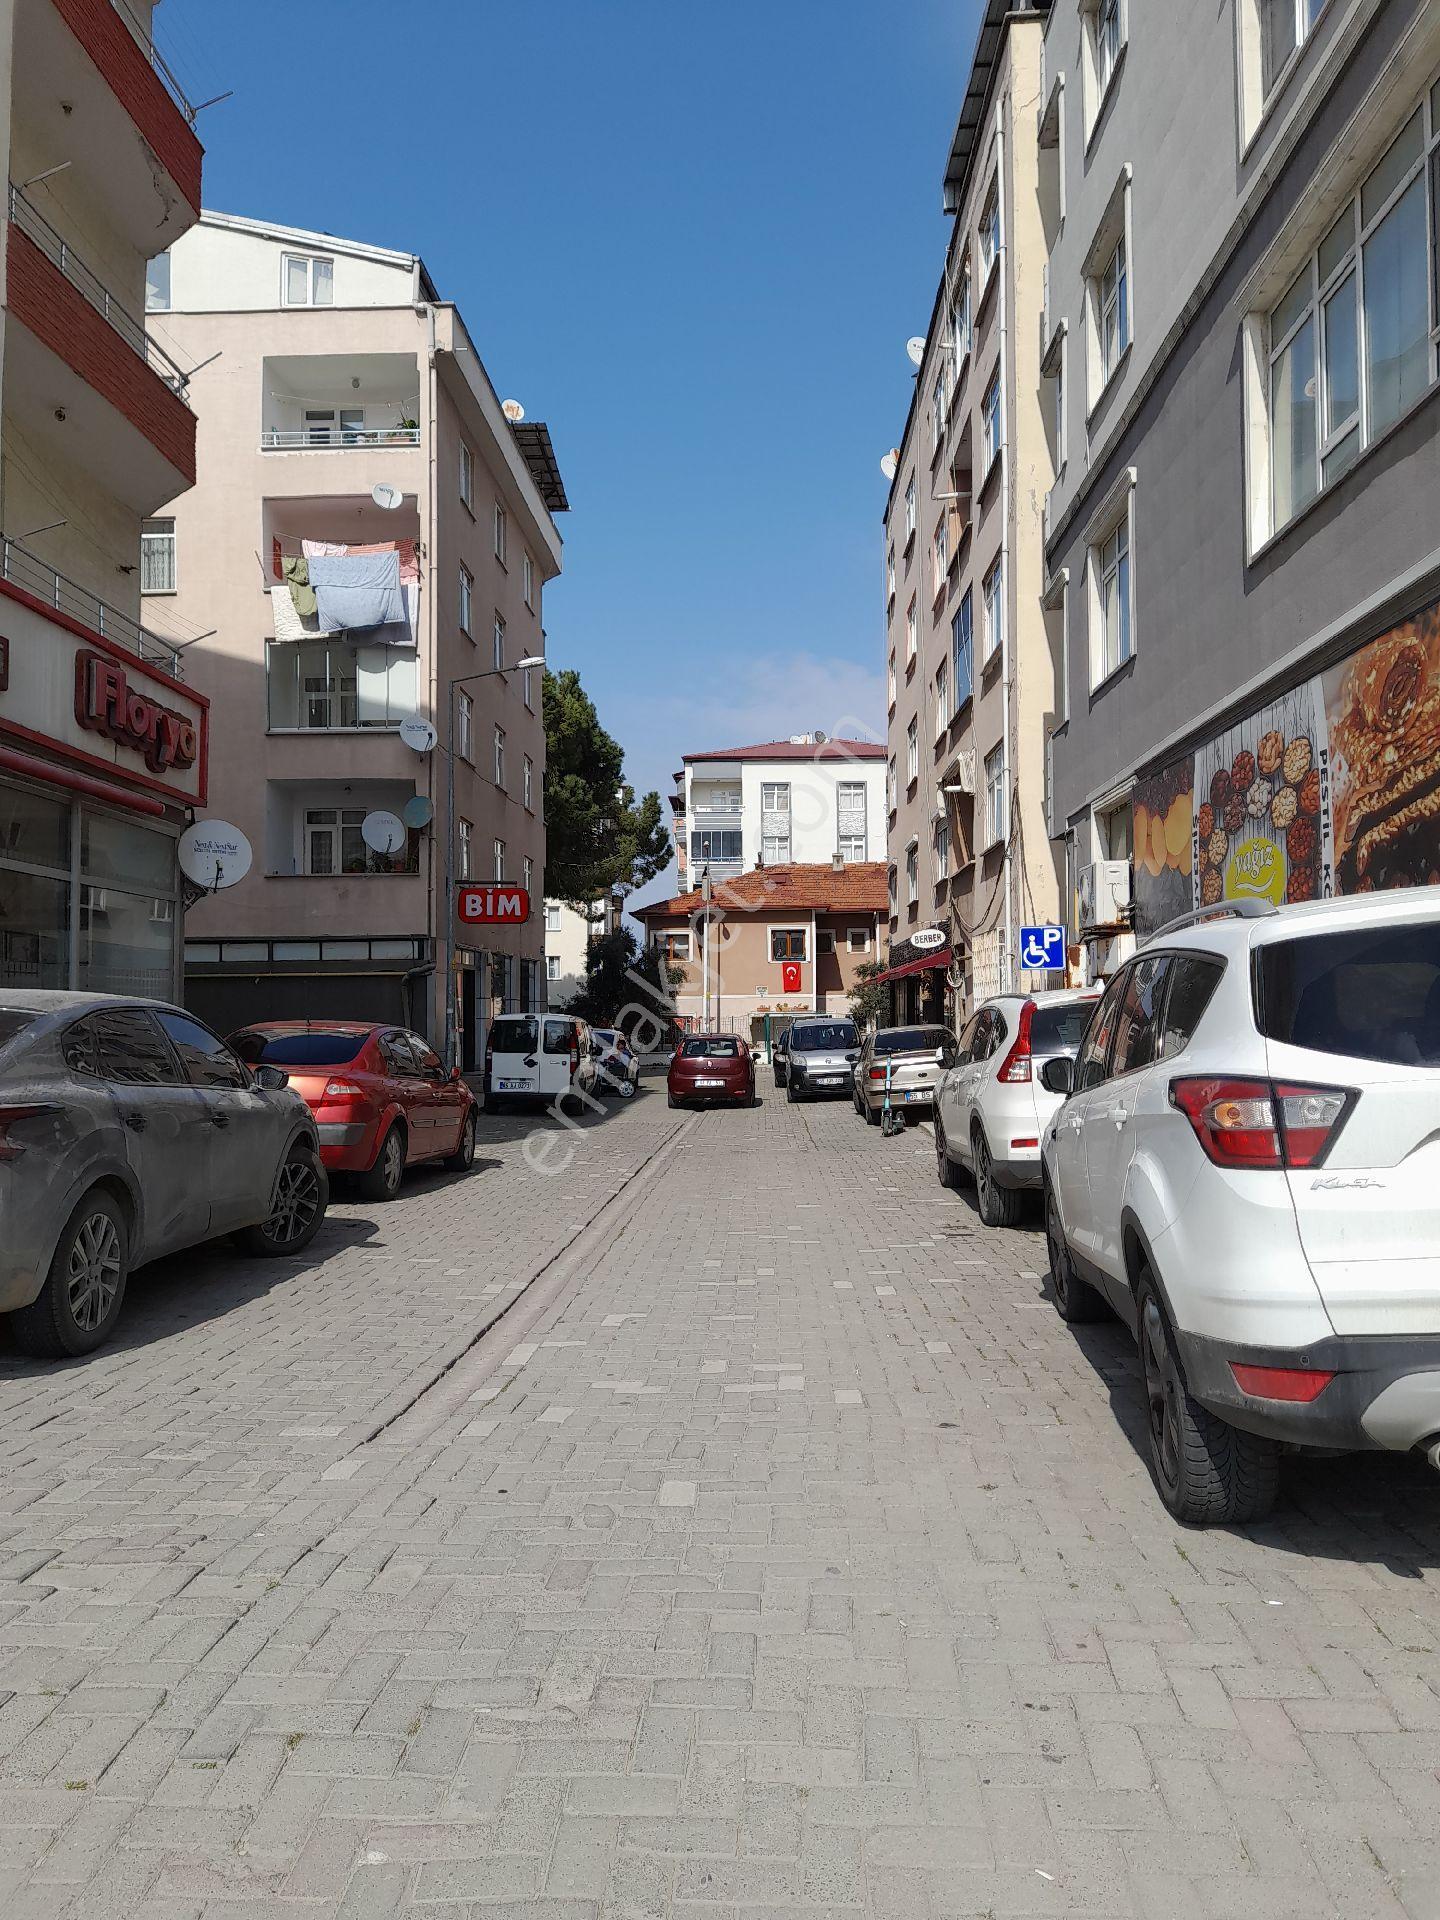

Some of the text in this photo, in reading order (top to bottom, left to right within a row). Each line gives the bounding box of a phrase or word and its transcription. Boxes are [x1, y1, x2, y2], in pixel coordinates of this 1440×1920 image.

[1319, 748, 1333, 899] PESTİL KÖ
[465, 888, 521, 917] BİM
[914, 933, 942, 945] BERBER
[1043, 928, 1061, 949] P
